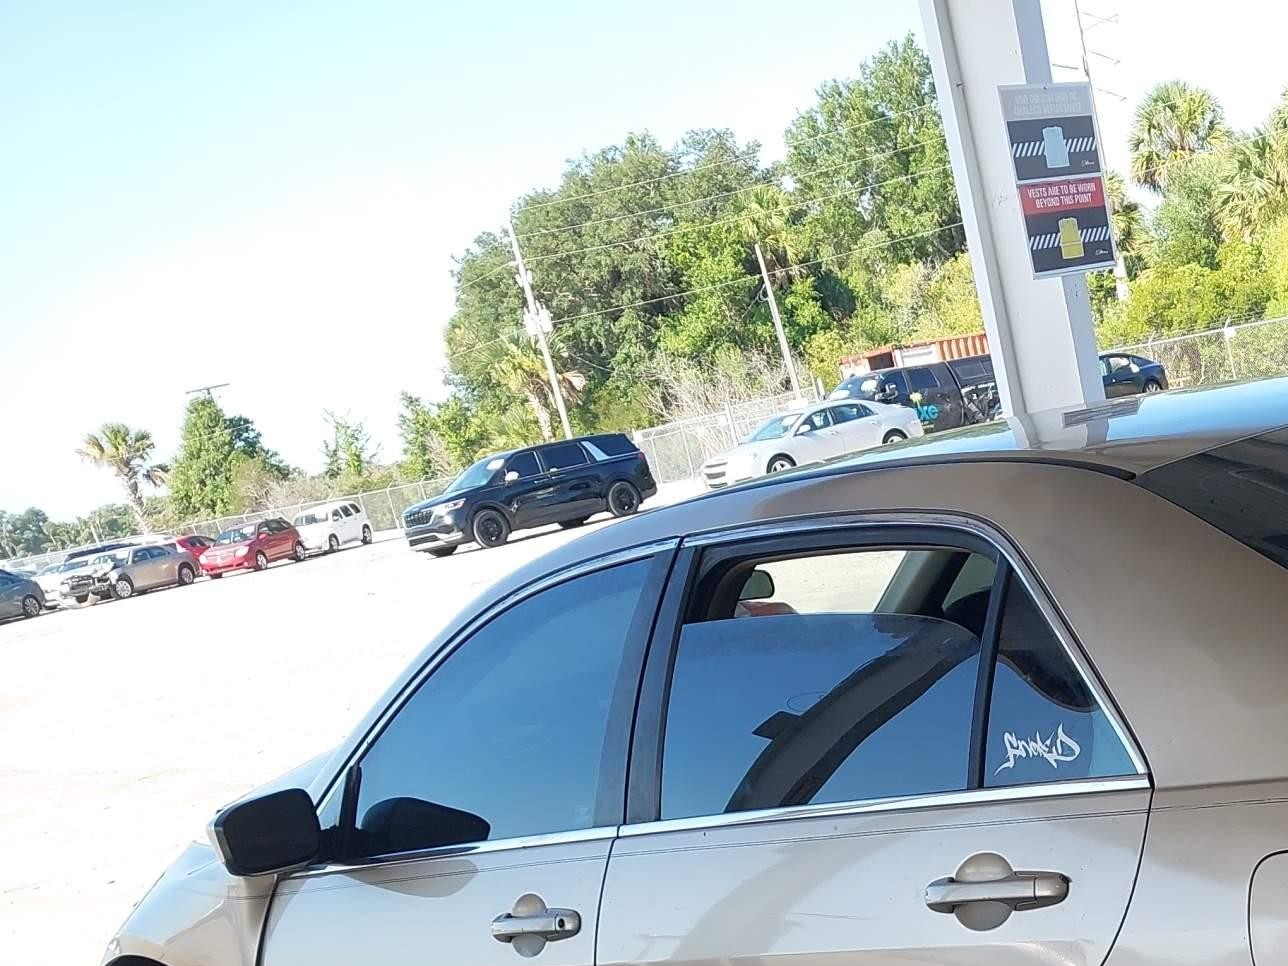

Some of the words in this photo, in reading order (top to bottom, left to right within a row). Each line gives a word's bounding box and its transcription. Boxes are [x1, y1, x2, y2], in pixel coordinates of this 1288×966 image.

[1027, 187, 1047, 199] VESTS
[1048, 185, 1060, 197] ARE
[1060, 184, 1069, 195] TO
[1069, 183, 1078, 193] BE
[1077, 182, 1096, 192] WORN
[1035, 196, 1060, 209] BEYOND
[1060, 194, 1075, 206] THIS
[1074, 193, 1092, 204] POINT
